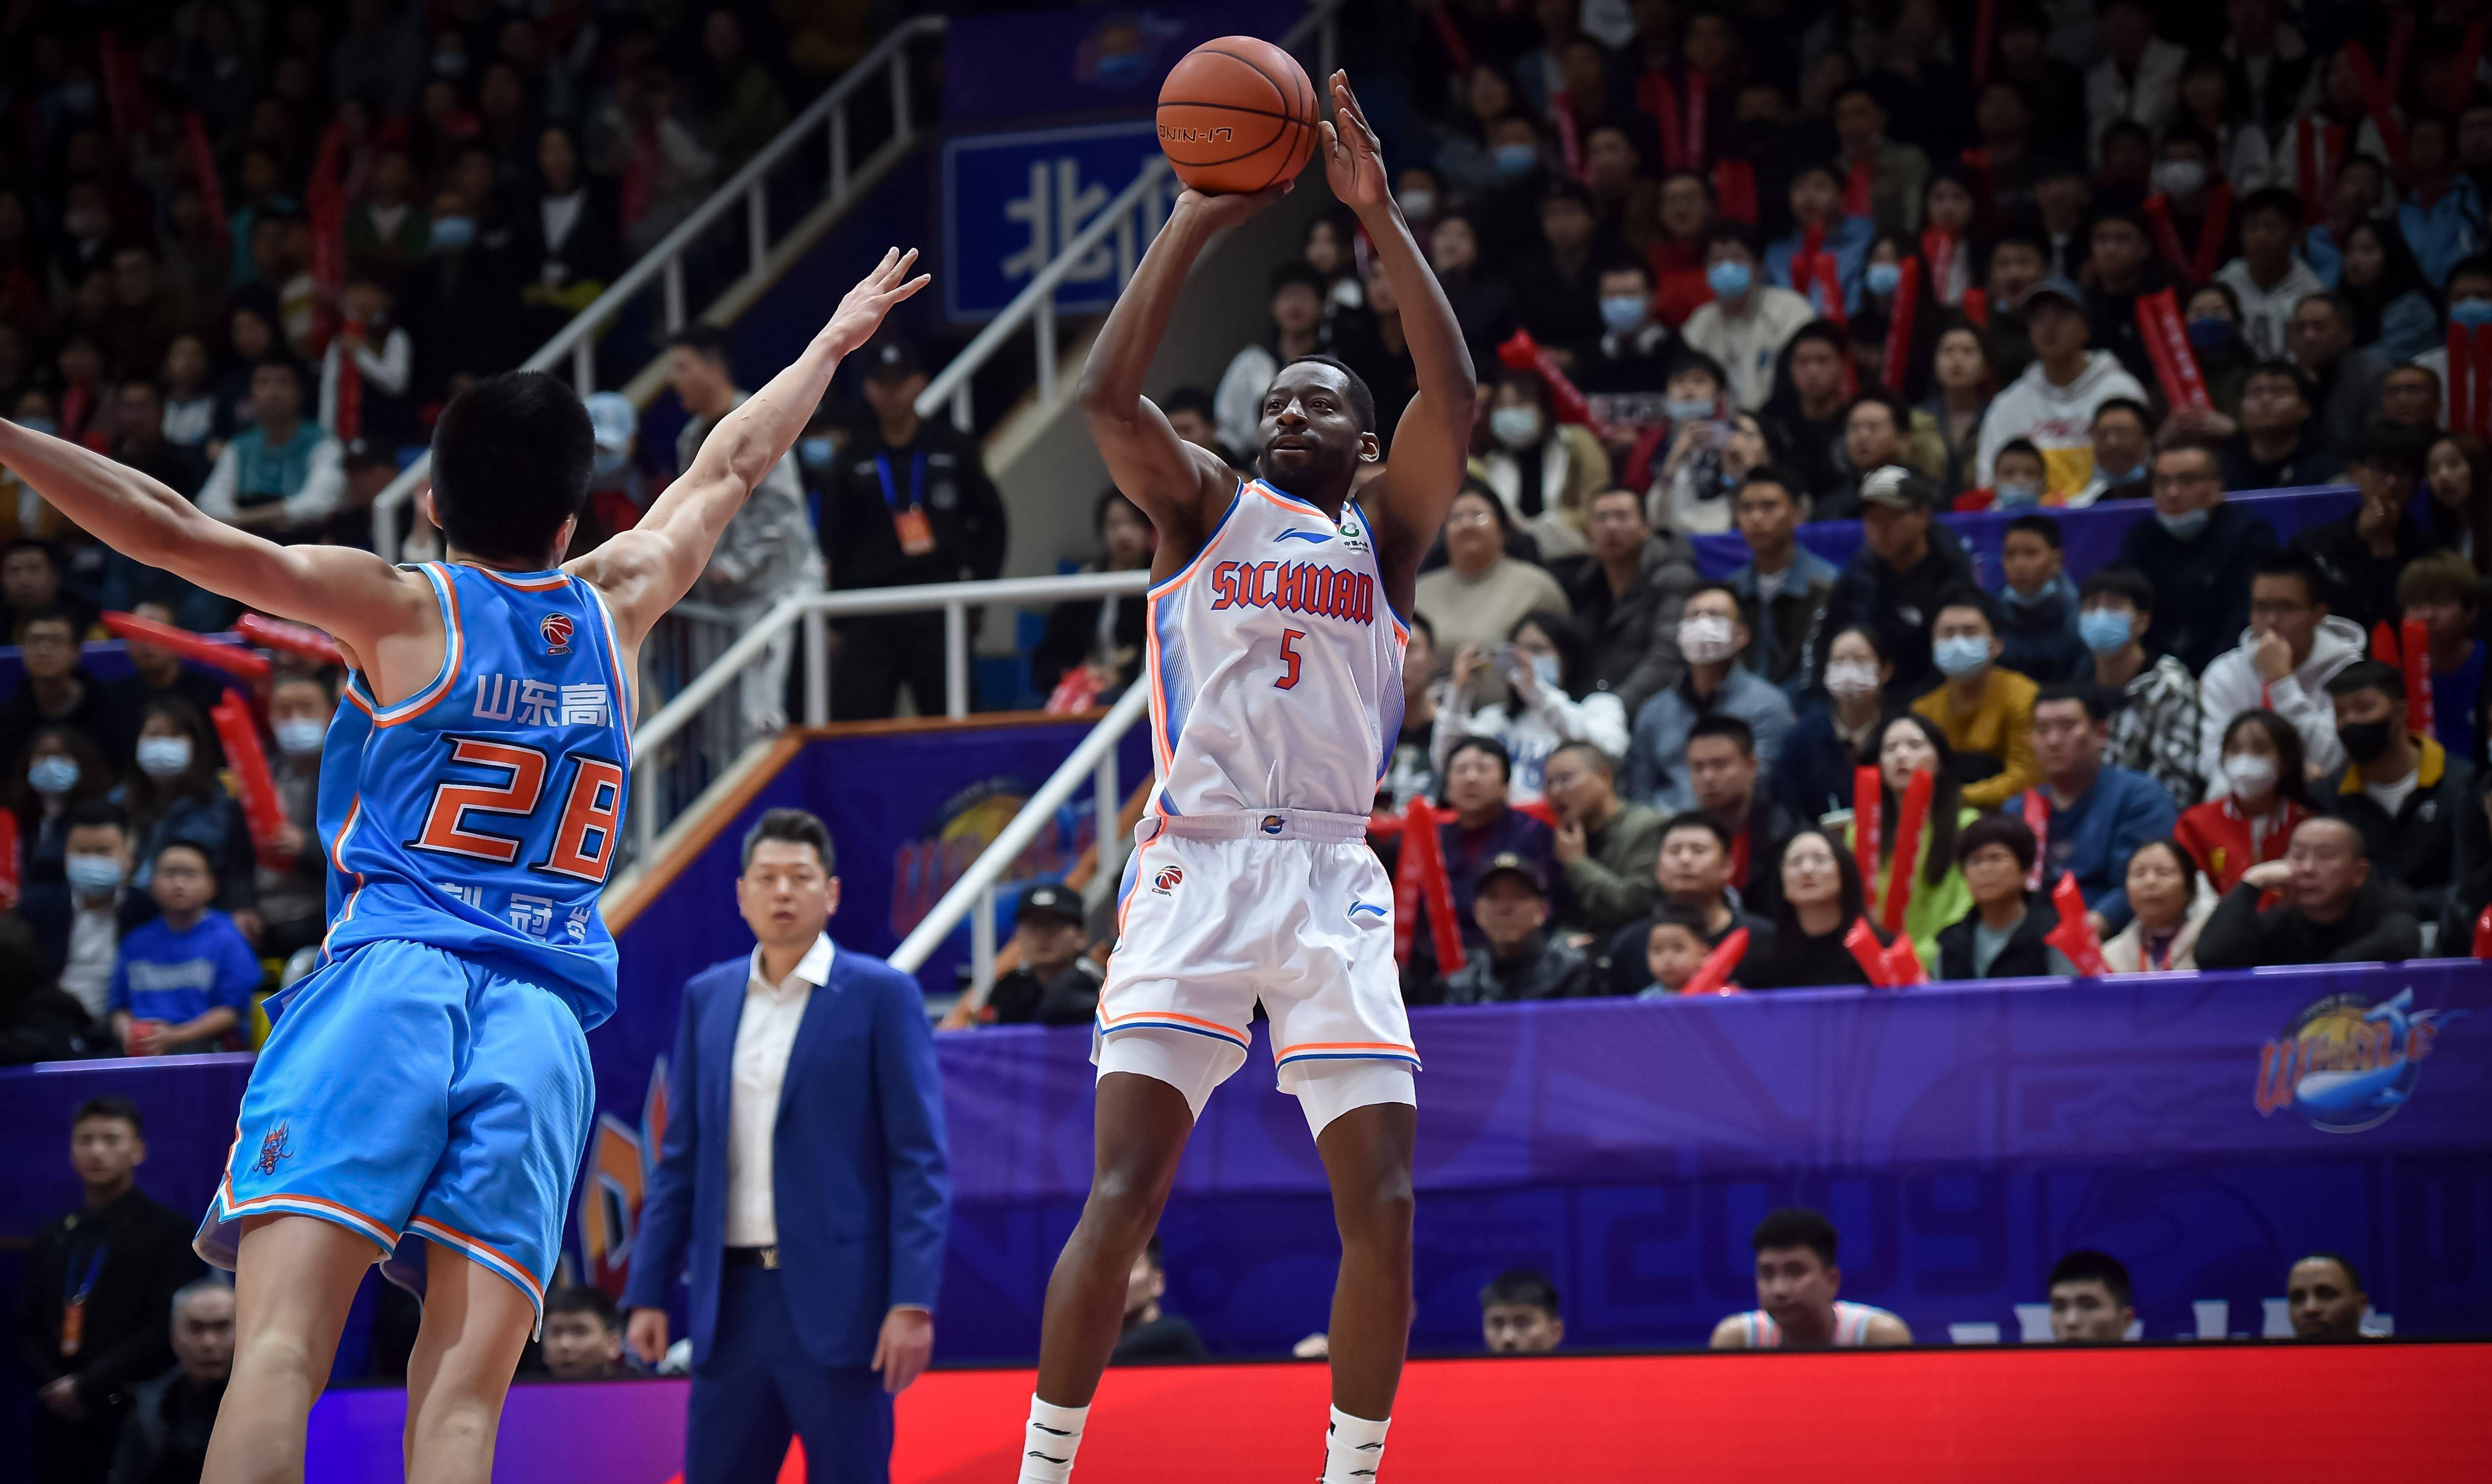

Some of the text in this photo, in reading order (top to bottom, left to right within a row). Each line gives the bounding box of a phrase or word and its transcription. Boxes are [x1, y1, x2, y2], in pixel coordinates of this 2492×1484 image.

[1160, 123, 1233, 143] LI-NING
[1211, 559, 1374, 627] SICHUAN
[547, 646, 573, 656] CBA
[1273, 627, 1307, 691] 5
[472, 673, 613, 729] 山东高
[403, 733, 623, 886] 28
